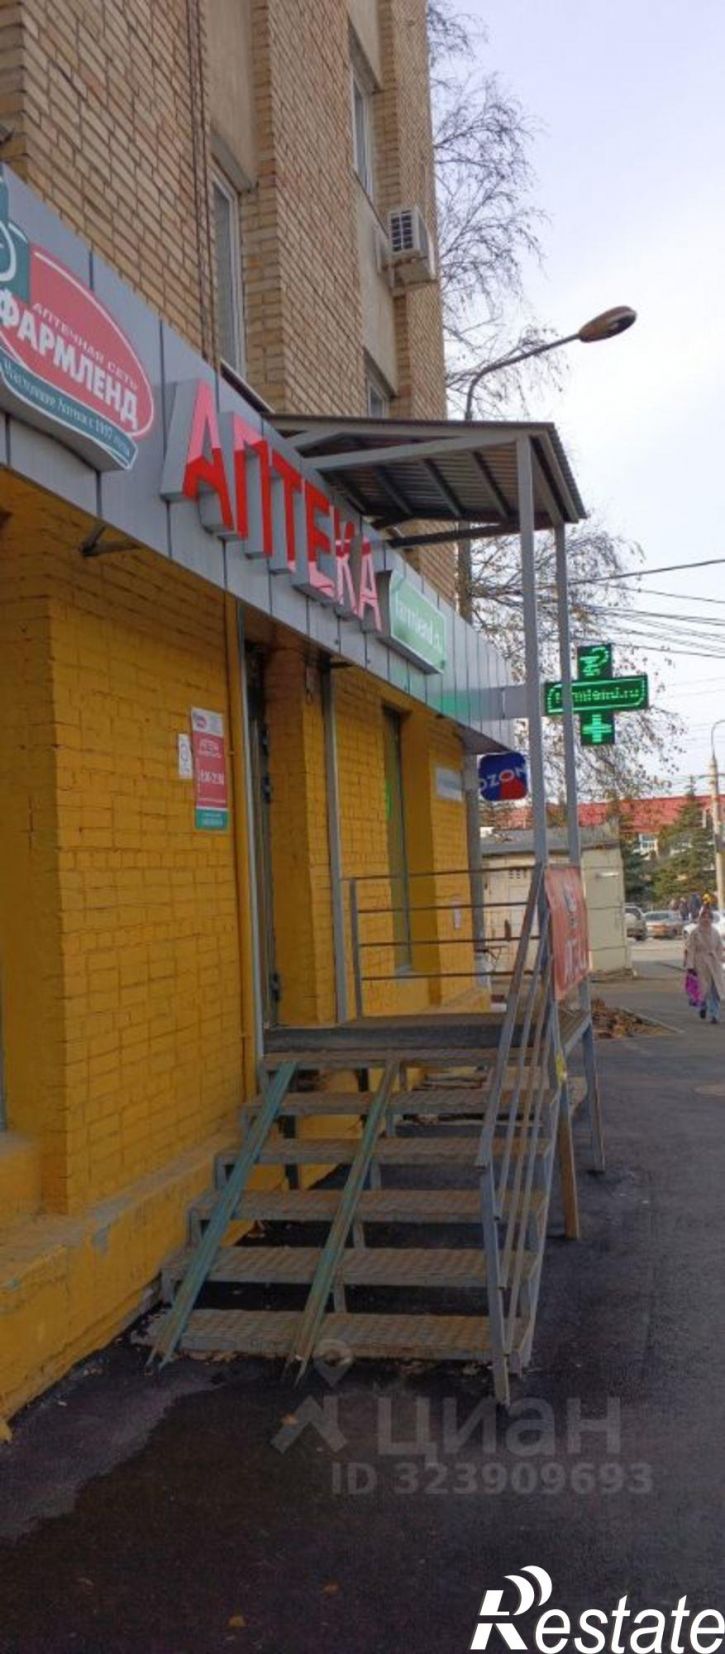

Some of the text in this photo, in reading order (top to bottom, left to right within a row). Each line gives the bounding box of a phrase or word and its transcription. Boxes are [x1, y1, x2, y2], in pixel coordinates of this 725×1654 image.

[0, 288, 138, 430] ФАРМЛЕНД
[32, 303, 104, 365] АПТЕЧНАЯ
[182, 378, 382, 632] АПТЕКА
